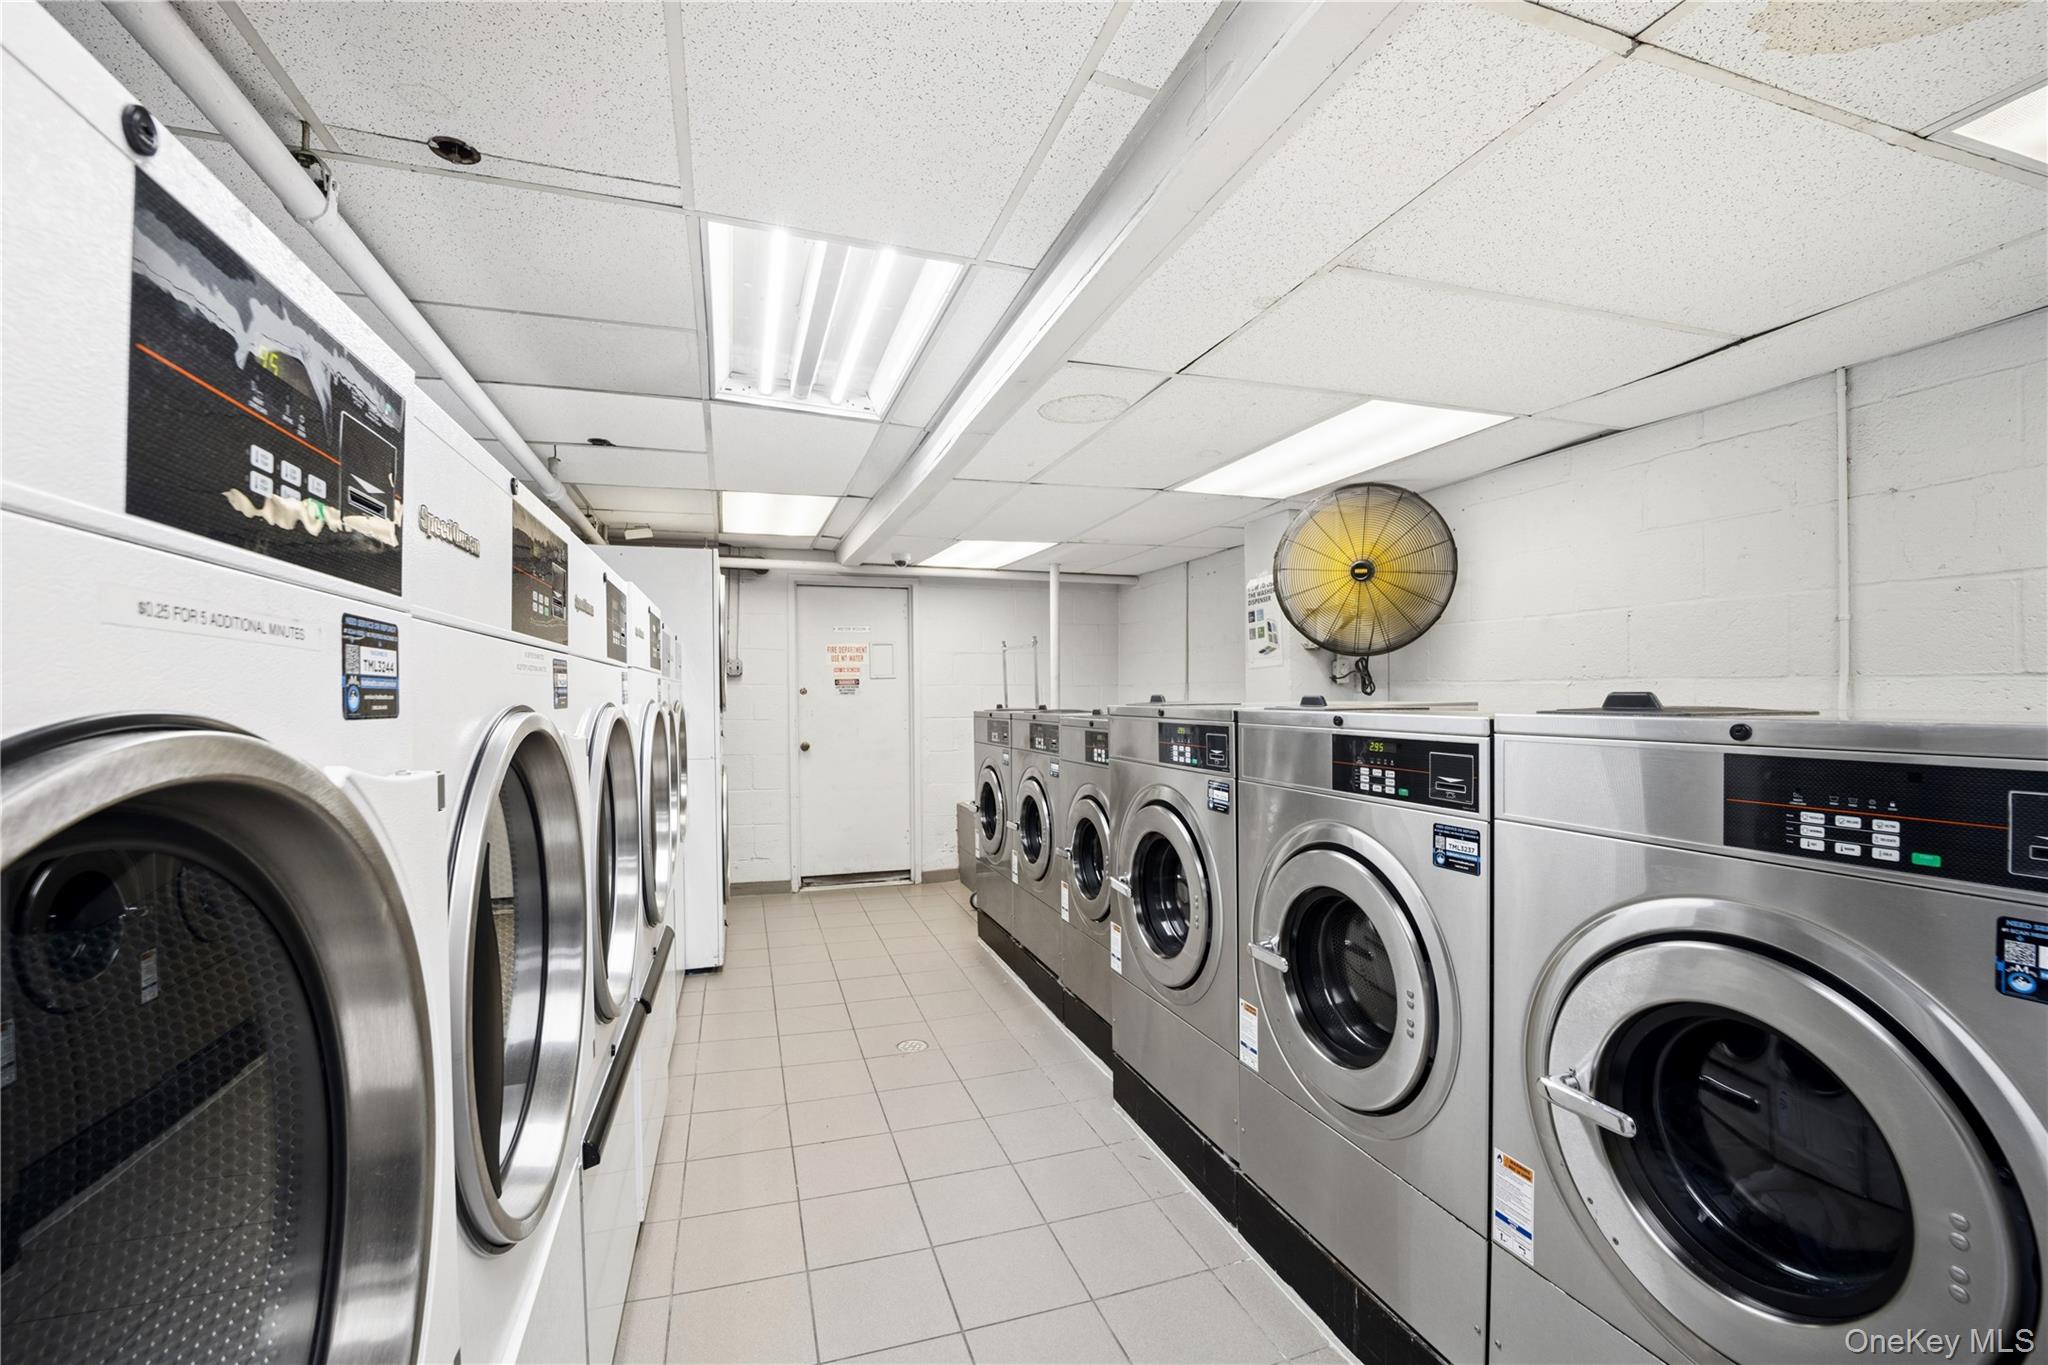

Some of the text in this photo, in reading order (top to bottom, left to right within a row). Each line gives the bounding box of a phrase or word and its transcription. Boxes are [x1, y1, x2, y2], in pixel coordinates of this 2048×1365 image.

[1248, 595, 1271, 605] DISPENSER
[173, 606, 198, 623] FOR
[200, 610, 207, 625] 5
[210, 613, 267, 635] ADDITIONAL
[269, 623, 306, 641] MINUTES
[827, 646, 867, 654] FIRE DEPARTMENT
[1448, 843, 1475, 853] TML3237
[2005, 920, 2032, 930] NEED
